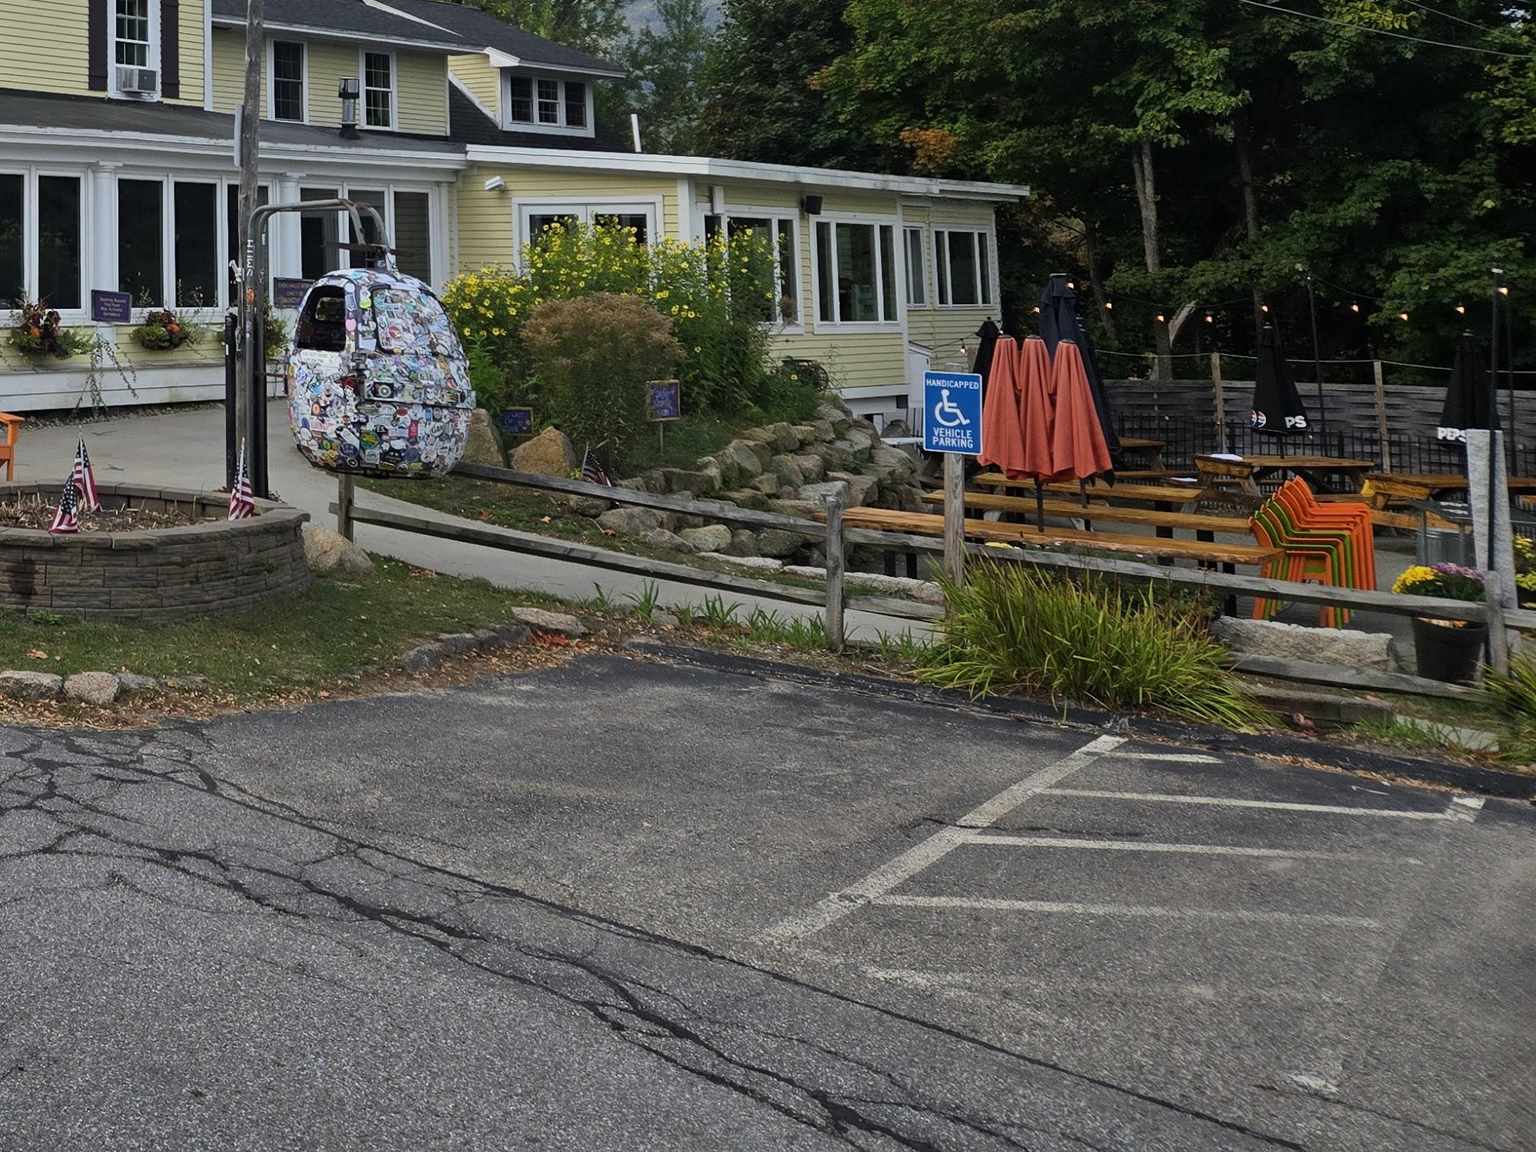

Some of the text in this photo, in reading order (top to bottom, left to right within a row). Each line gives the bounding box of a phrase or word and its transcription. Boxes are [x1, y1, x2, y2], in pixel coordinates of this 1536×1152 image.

[246, 239, 254, 277] SMITH
[926, 379, 979, 389] HANDICAPPED
[933, 427, 972, 439] VEHICLE
[932, 437, 974, 448] PARKING
